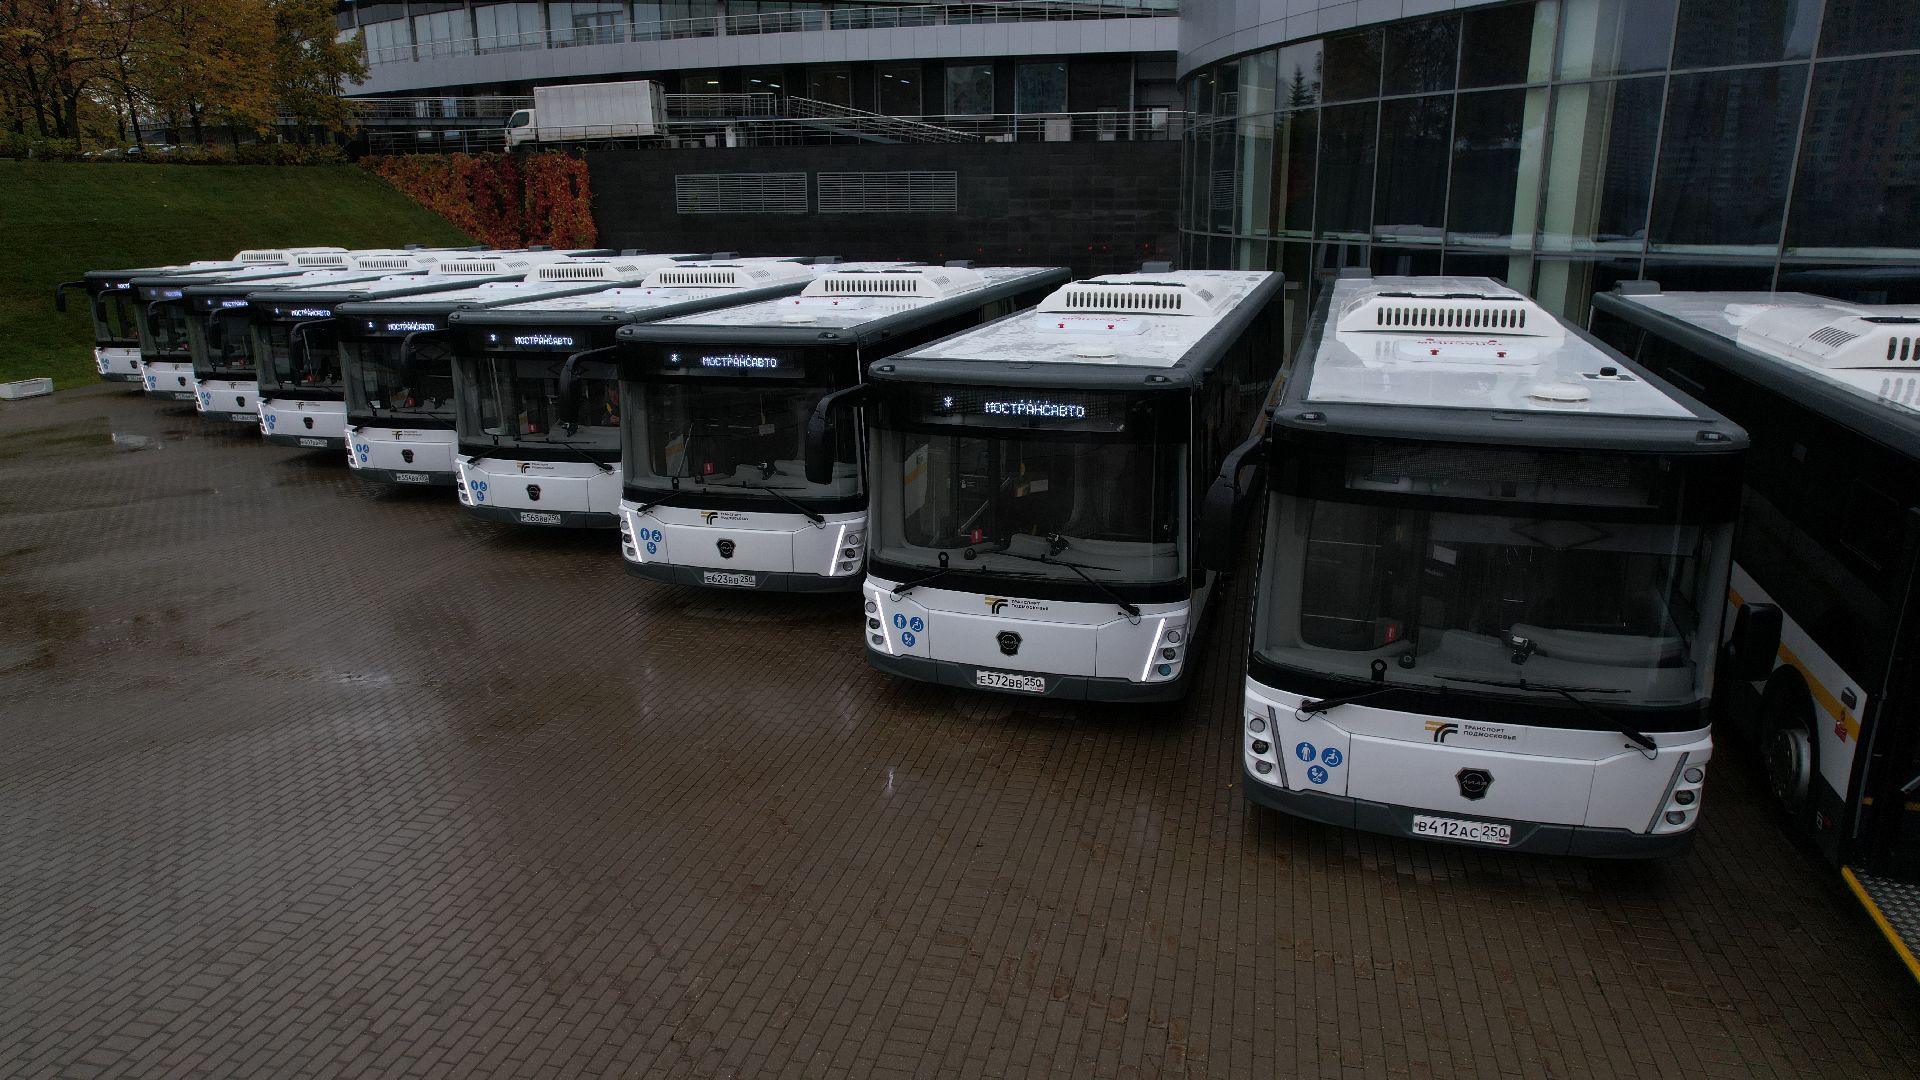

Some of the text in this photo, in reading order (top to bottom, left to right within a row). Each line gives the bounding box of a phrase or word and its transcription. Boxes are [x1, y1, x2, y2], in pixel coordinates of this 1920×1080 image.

[514, 336, 573, 345] МОСТРАНСАВТО
[702, 356, 777, 368] МОСТРАНСАВТО
[985, 402, 1085, 417] МОСТРАНСАВТО
[706, 574, 739, 585] Е623ВВ
[980, 674, 1043, 689] Е572ВВ 250
[1464, 724, 1505, 733] ТРАНСПОРТ
[1463, 731, 1517, 741] ПОДМОСКОВЬЕ
[1417, 820, 1507, 839] В412АС 250
